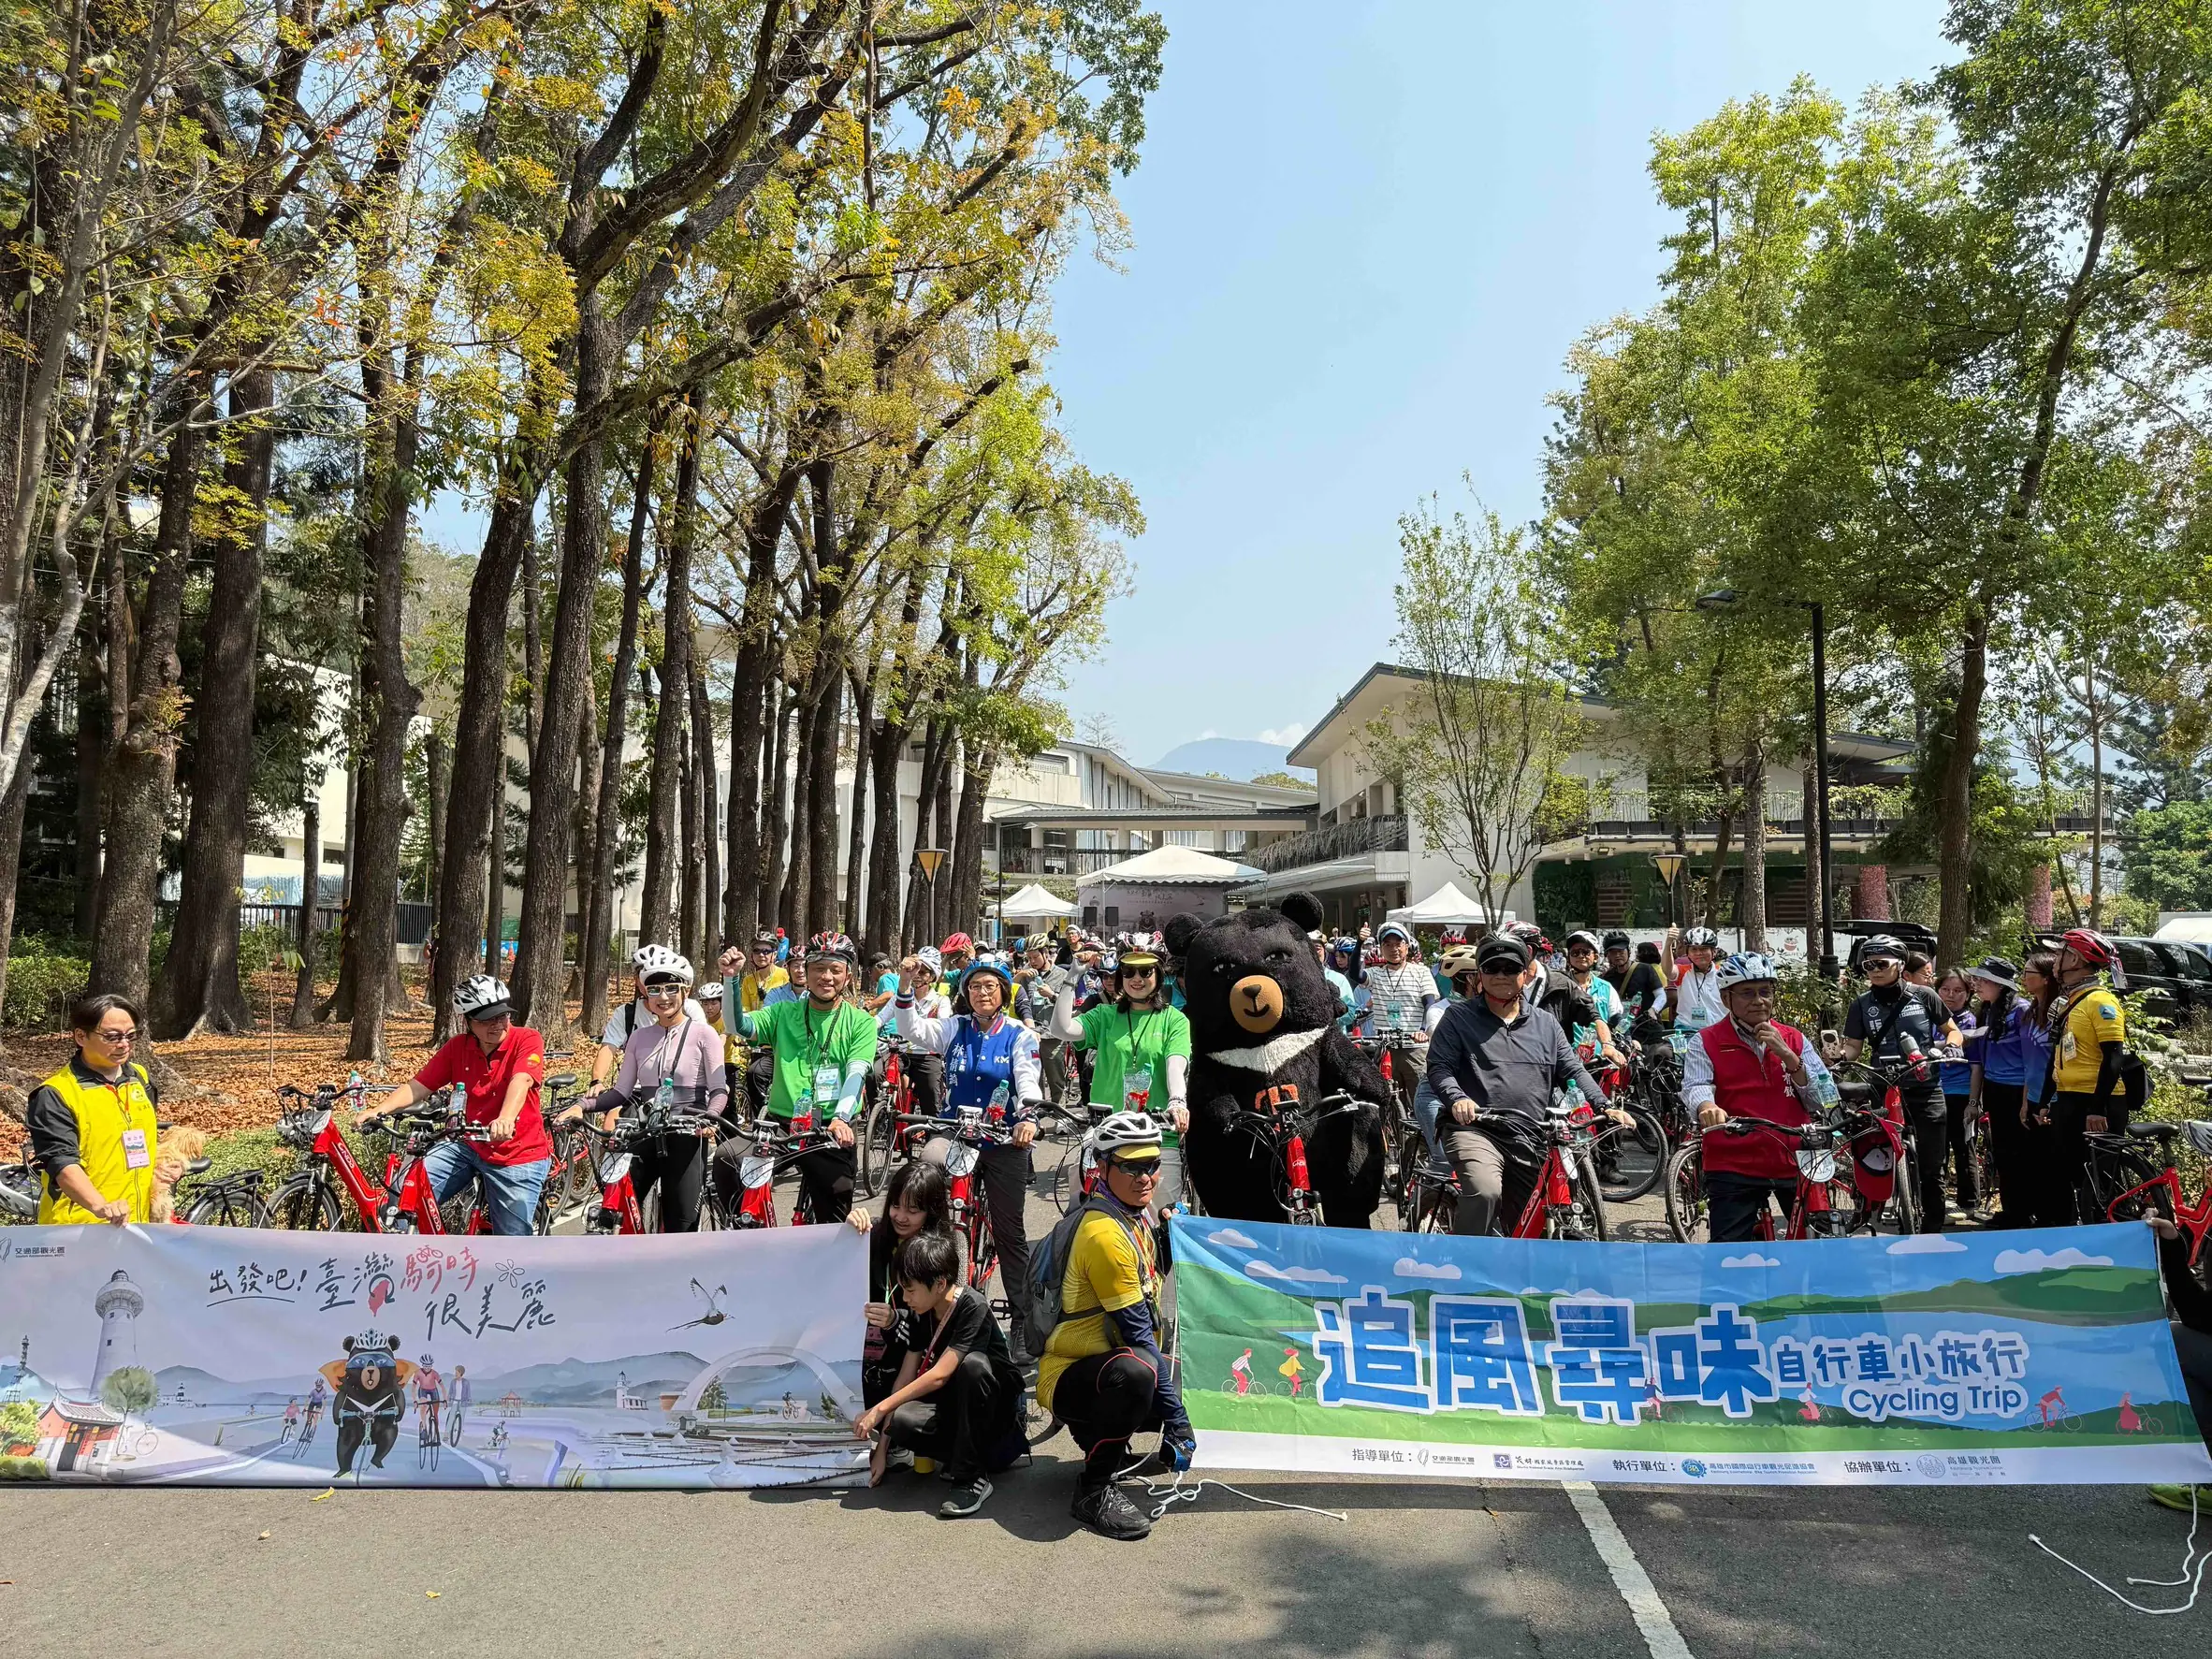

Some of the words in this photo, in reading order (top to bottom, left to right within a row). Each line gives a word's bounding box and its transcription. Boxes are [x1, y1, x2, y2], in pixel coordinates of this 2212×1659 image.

[425, 1279, 556, 1341] 很美麗
[1315, 1289, 1776, 1421] 追風尋味
[1776, 1337, 2028, 1382] 自行車小旅行
[1849, 1385, 1959, 1417] Cycling
[1966, 1384, 2021, 1417] Trip
